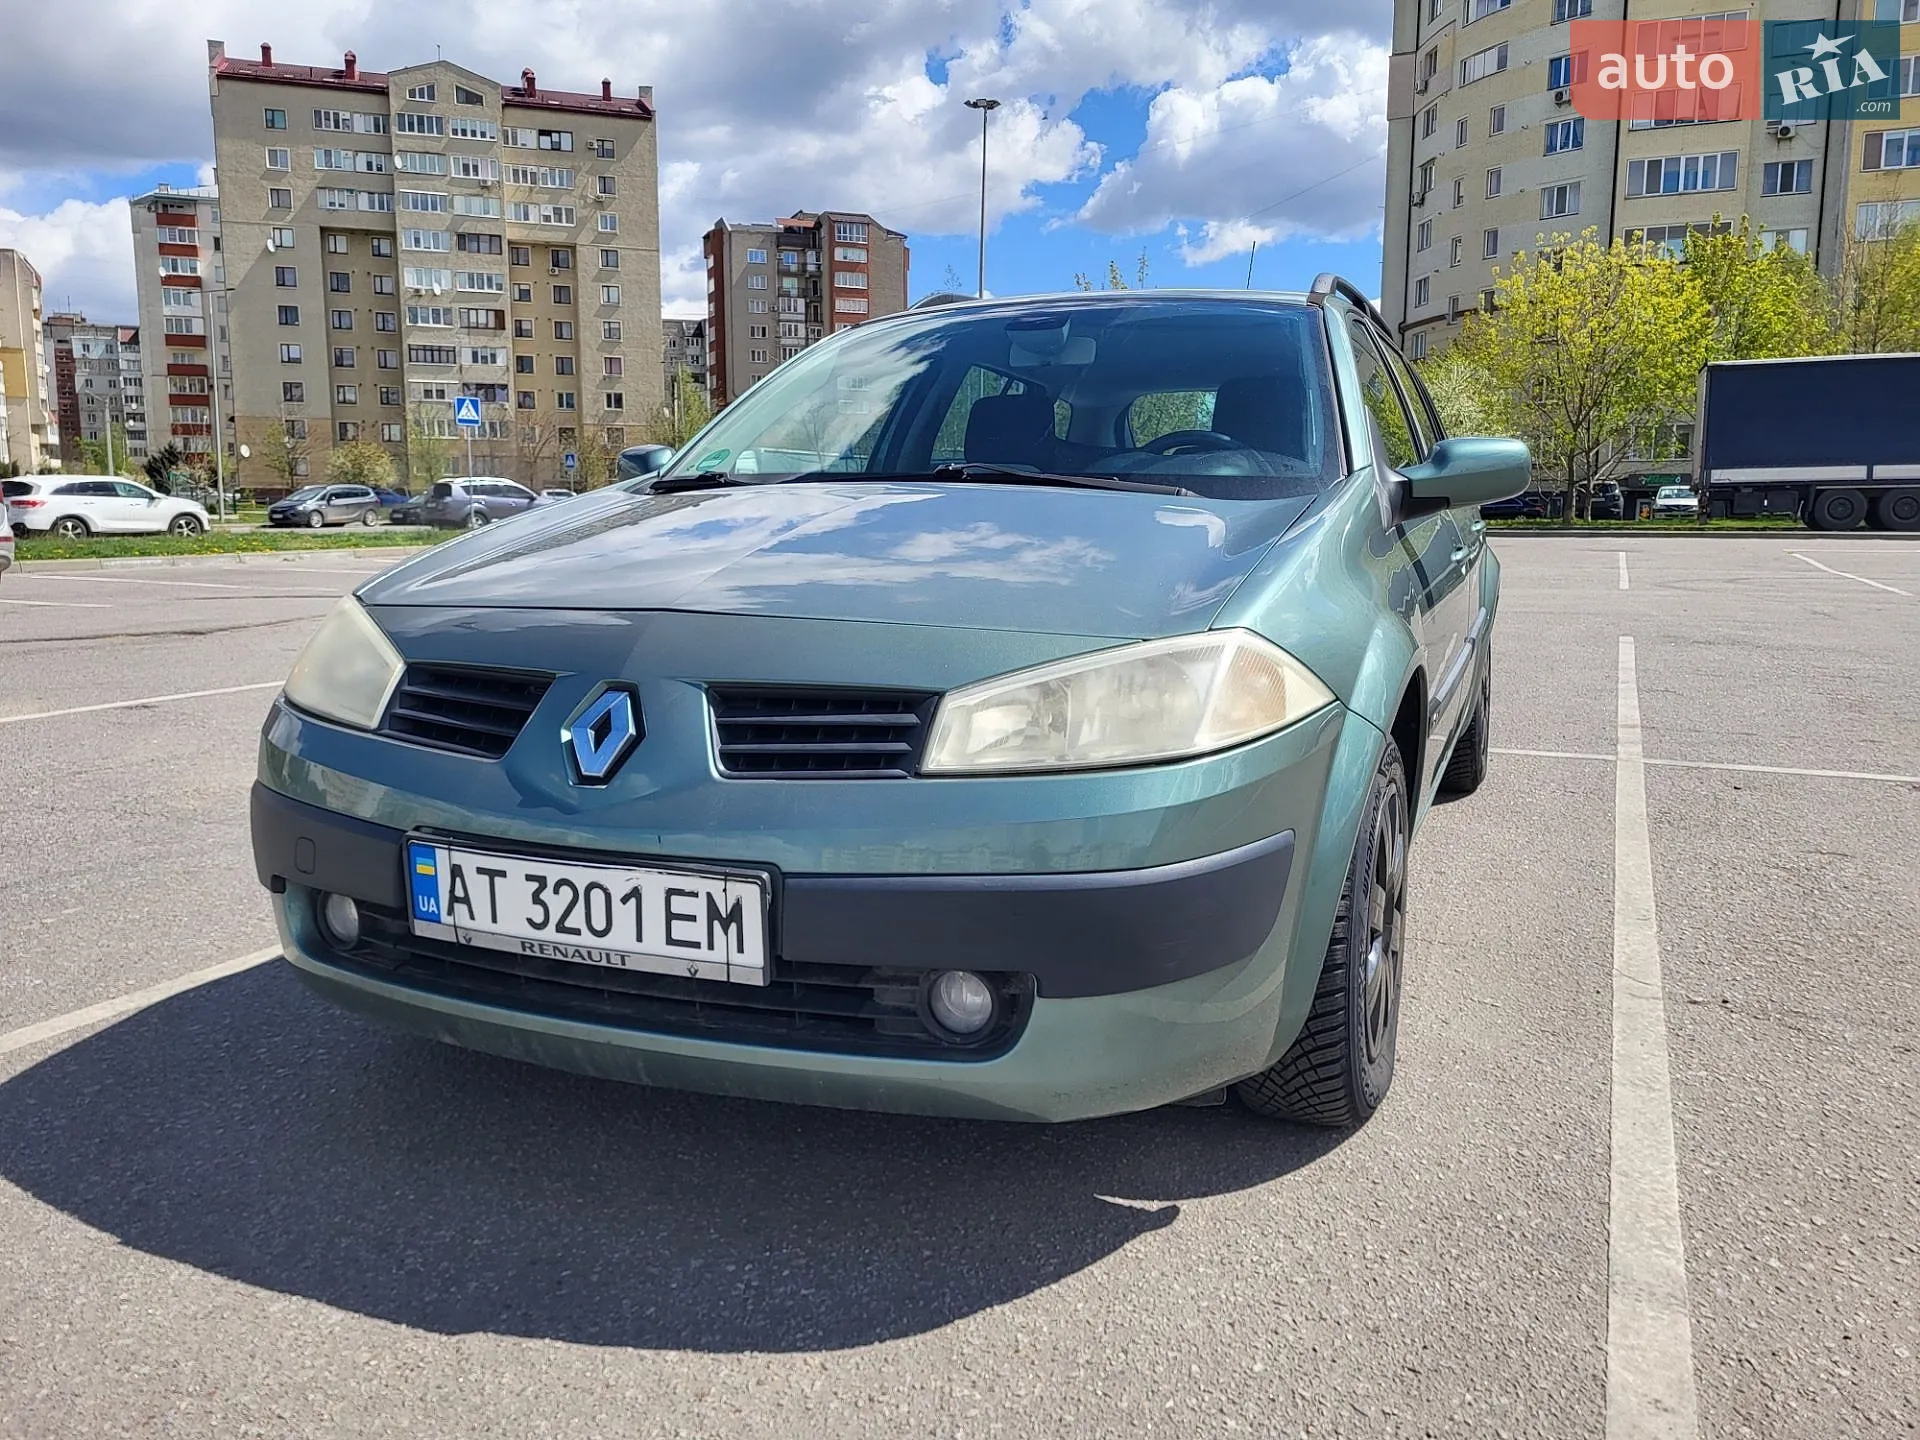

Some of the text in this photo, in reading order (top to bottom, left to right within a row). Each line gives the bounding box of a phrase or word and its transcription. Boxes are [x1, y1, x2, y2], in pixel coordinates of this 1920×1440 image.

[418, 894, 439, 915] UA
[446, 863, 745, 954] AT 3201 EM
[519, 940, 632, 967] RENAULT
